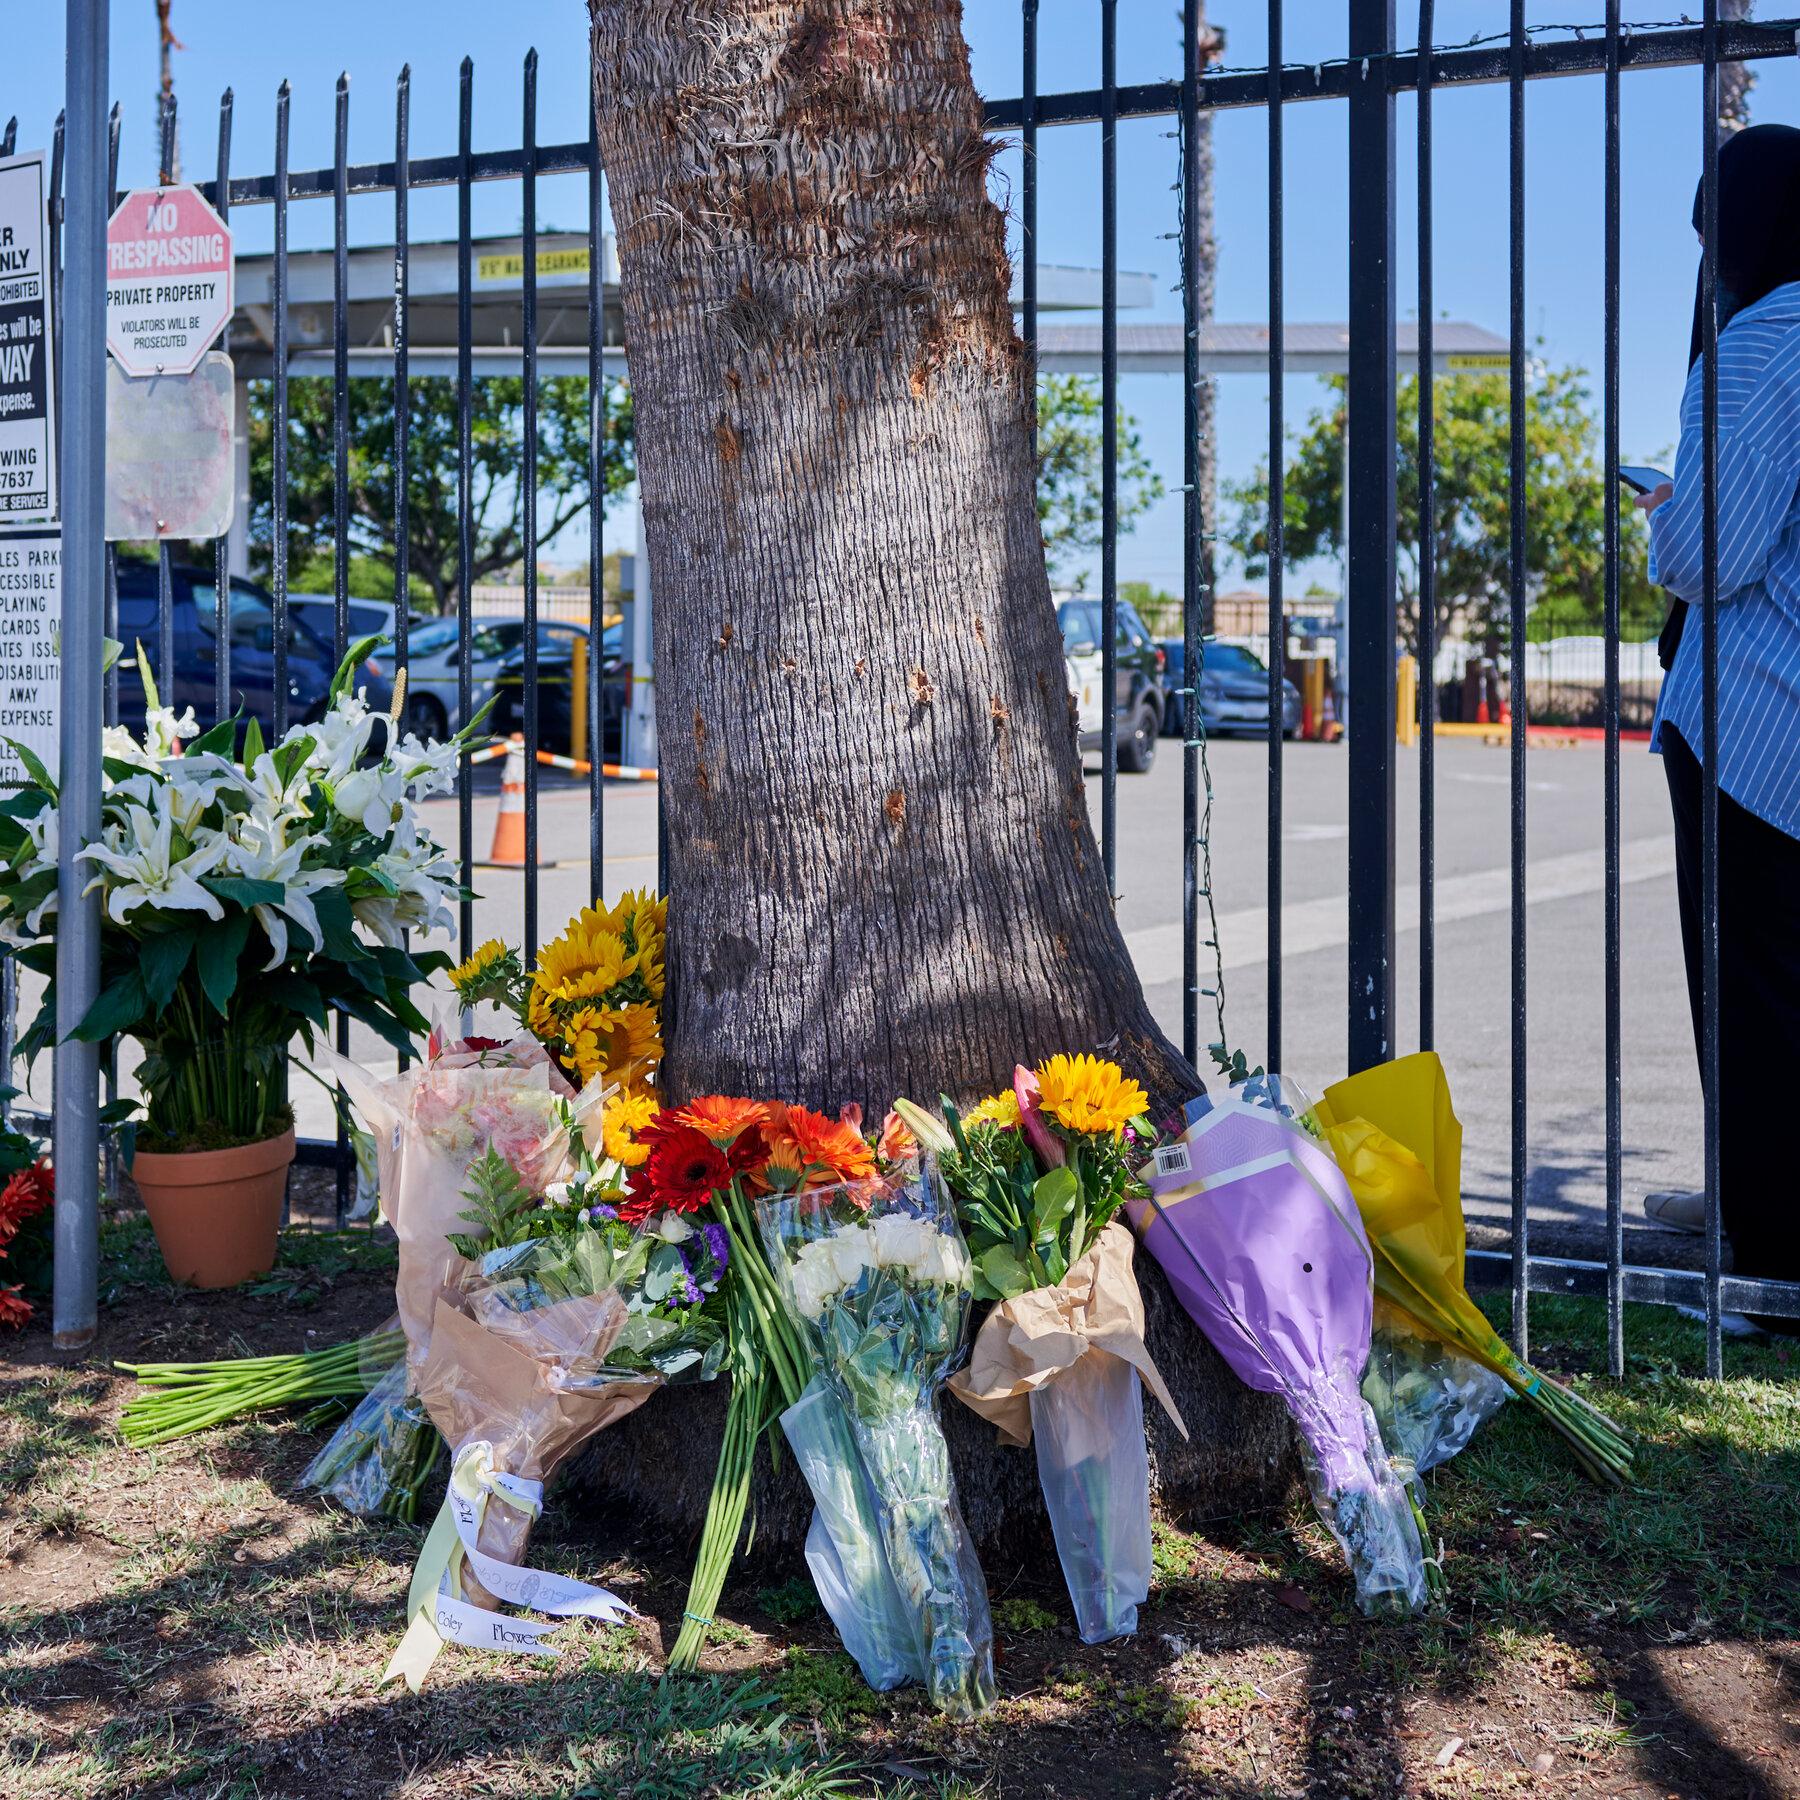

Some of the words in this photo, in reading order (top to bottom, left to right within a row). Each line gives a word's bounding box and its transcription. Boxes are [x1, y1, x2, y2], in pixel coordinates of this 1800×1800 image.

[147, 203, 178, 233] NO
[107, 287, 152, 307] PRIVATE
[157, 282, 216, 304] PROPERTY
[10, 316, 27, 338] will
[28, 314, 42, 336] be
[121, 318, 166, 334] VIOLATORS
[168, 316, 187, 330] WILL
[189, 316, 200, 329] BE
[133, 335, 187, 350] PROSECUTED
[10, 493, 47, 510] SERVICE
[28, 550, 61, 567] PARK
[9, 687, 38, 704] AWAY
[2, 710, 53, 727] EXPENSE
[437, 1611, 463, 1635] Coley
